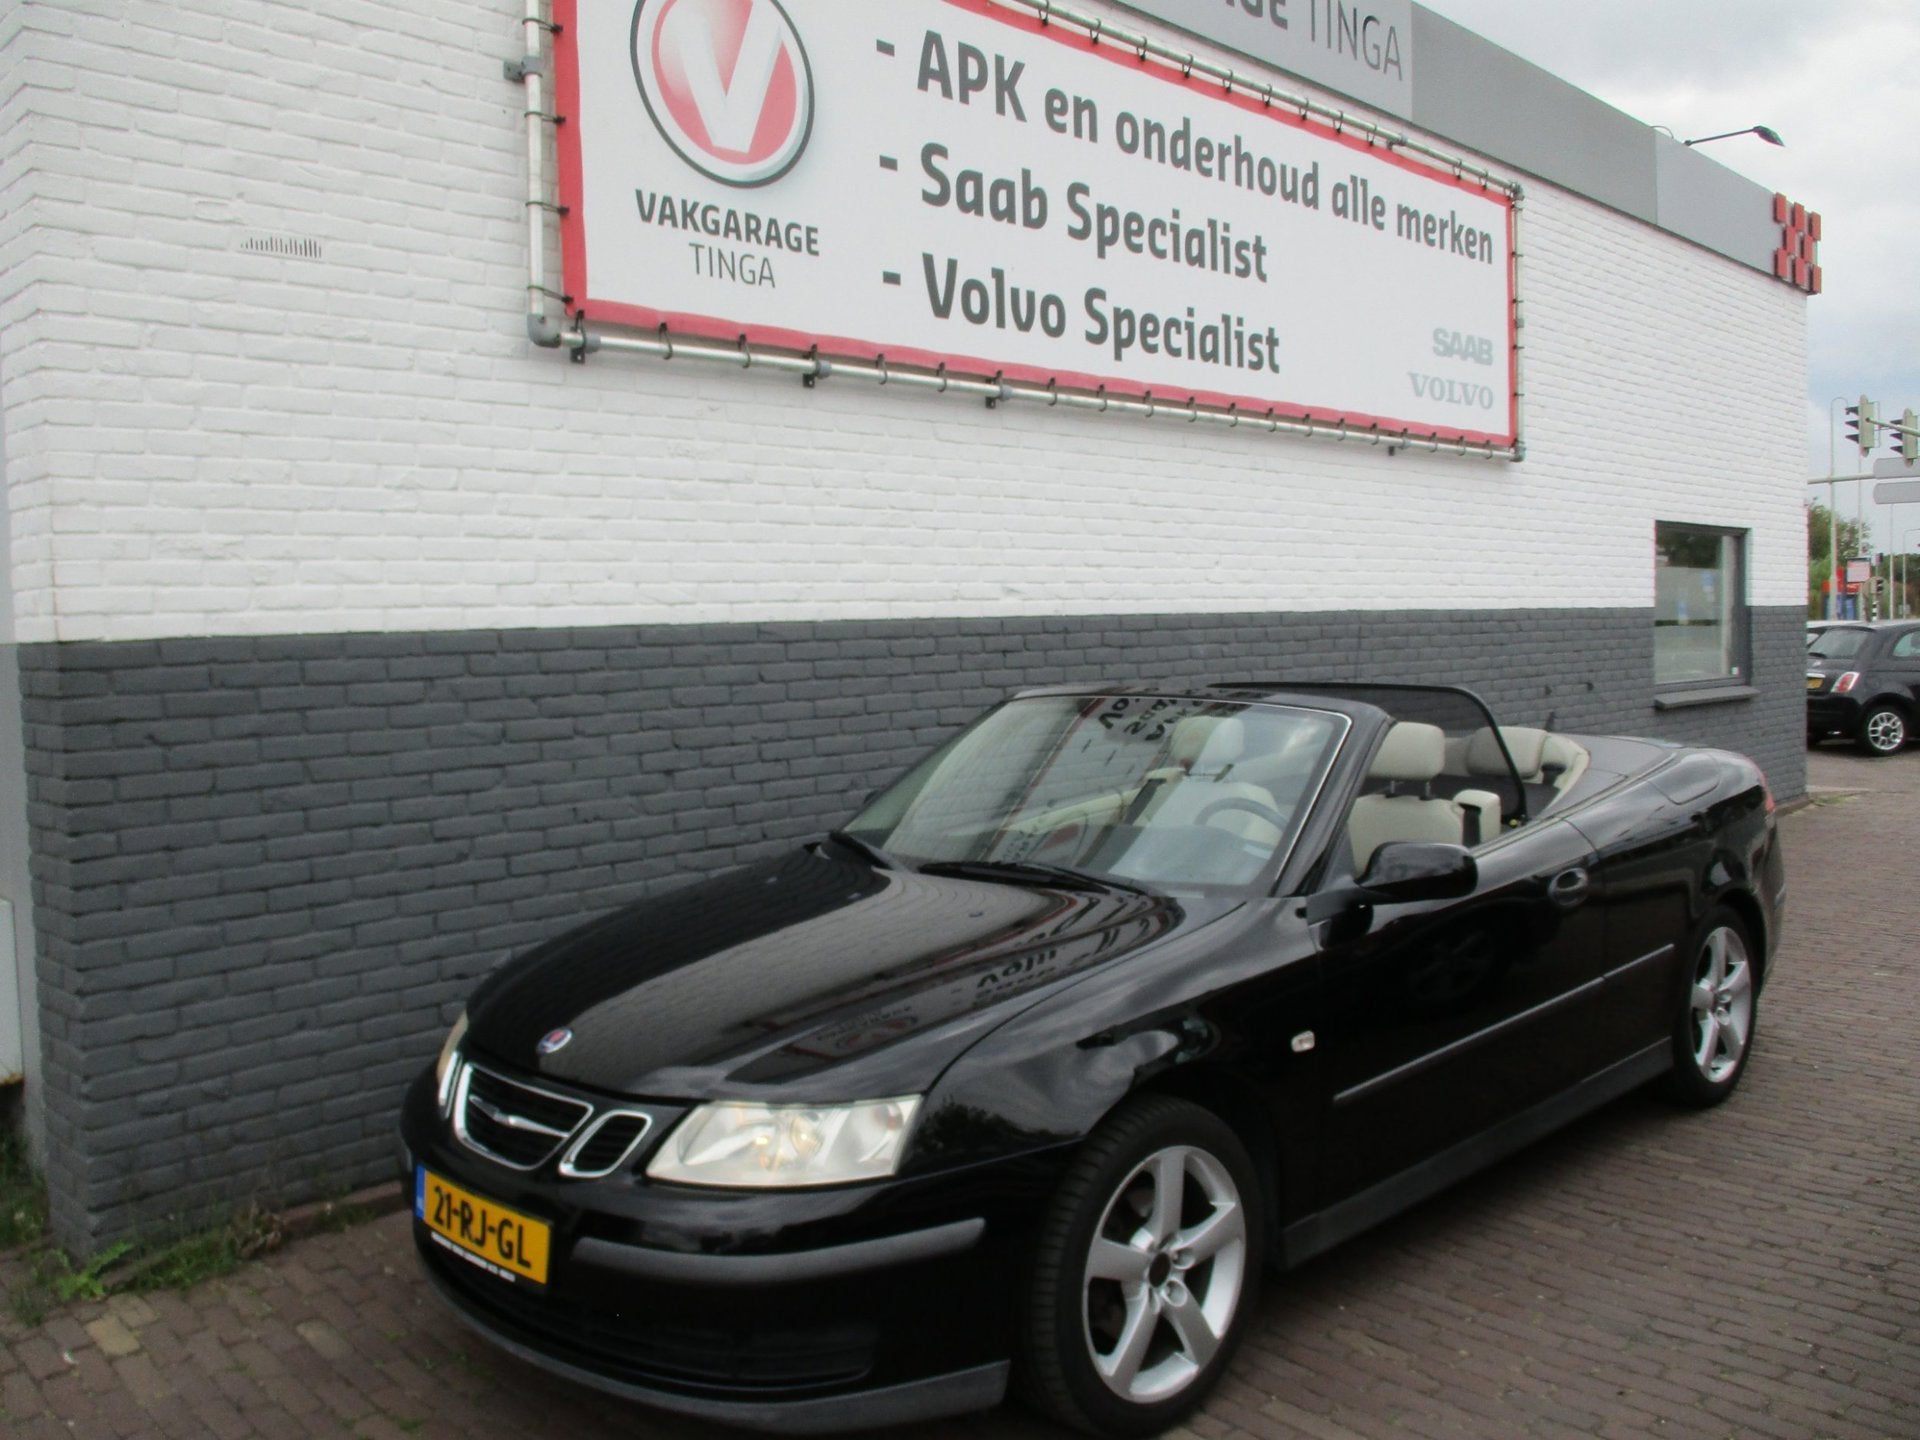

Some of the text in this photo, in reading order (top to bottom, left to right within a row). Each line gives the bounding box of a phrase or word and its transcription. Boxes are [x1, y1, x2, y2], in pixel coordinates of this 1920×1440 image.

[917, 29, 1028, 123] APK
[1044, 87, 1098, 143] en
[1115, 111, 1319, 210] onderhoud
[1332, 174, 1386, 230] alle
[1397, 201, 1493, 264] merken
[635, 188, 820, 256] VAKGARAGE
[921, 142, 1048, 230] Saab
[1066, 181, 1267, 283] Specialist
[688, 241, 776, 289] TINGA
[922, 251, 1066, 338] Volvo
[1084, 286, 1280, 374] Specialist
[1432, 327, 1493, 366] SAAB
[1406, 371, 1494, 410] VOLVO
[433, 1185, 532, 1270] 21-RJ-GL
